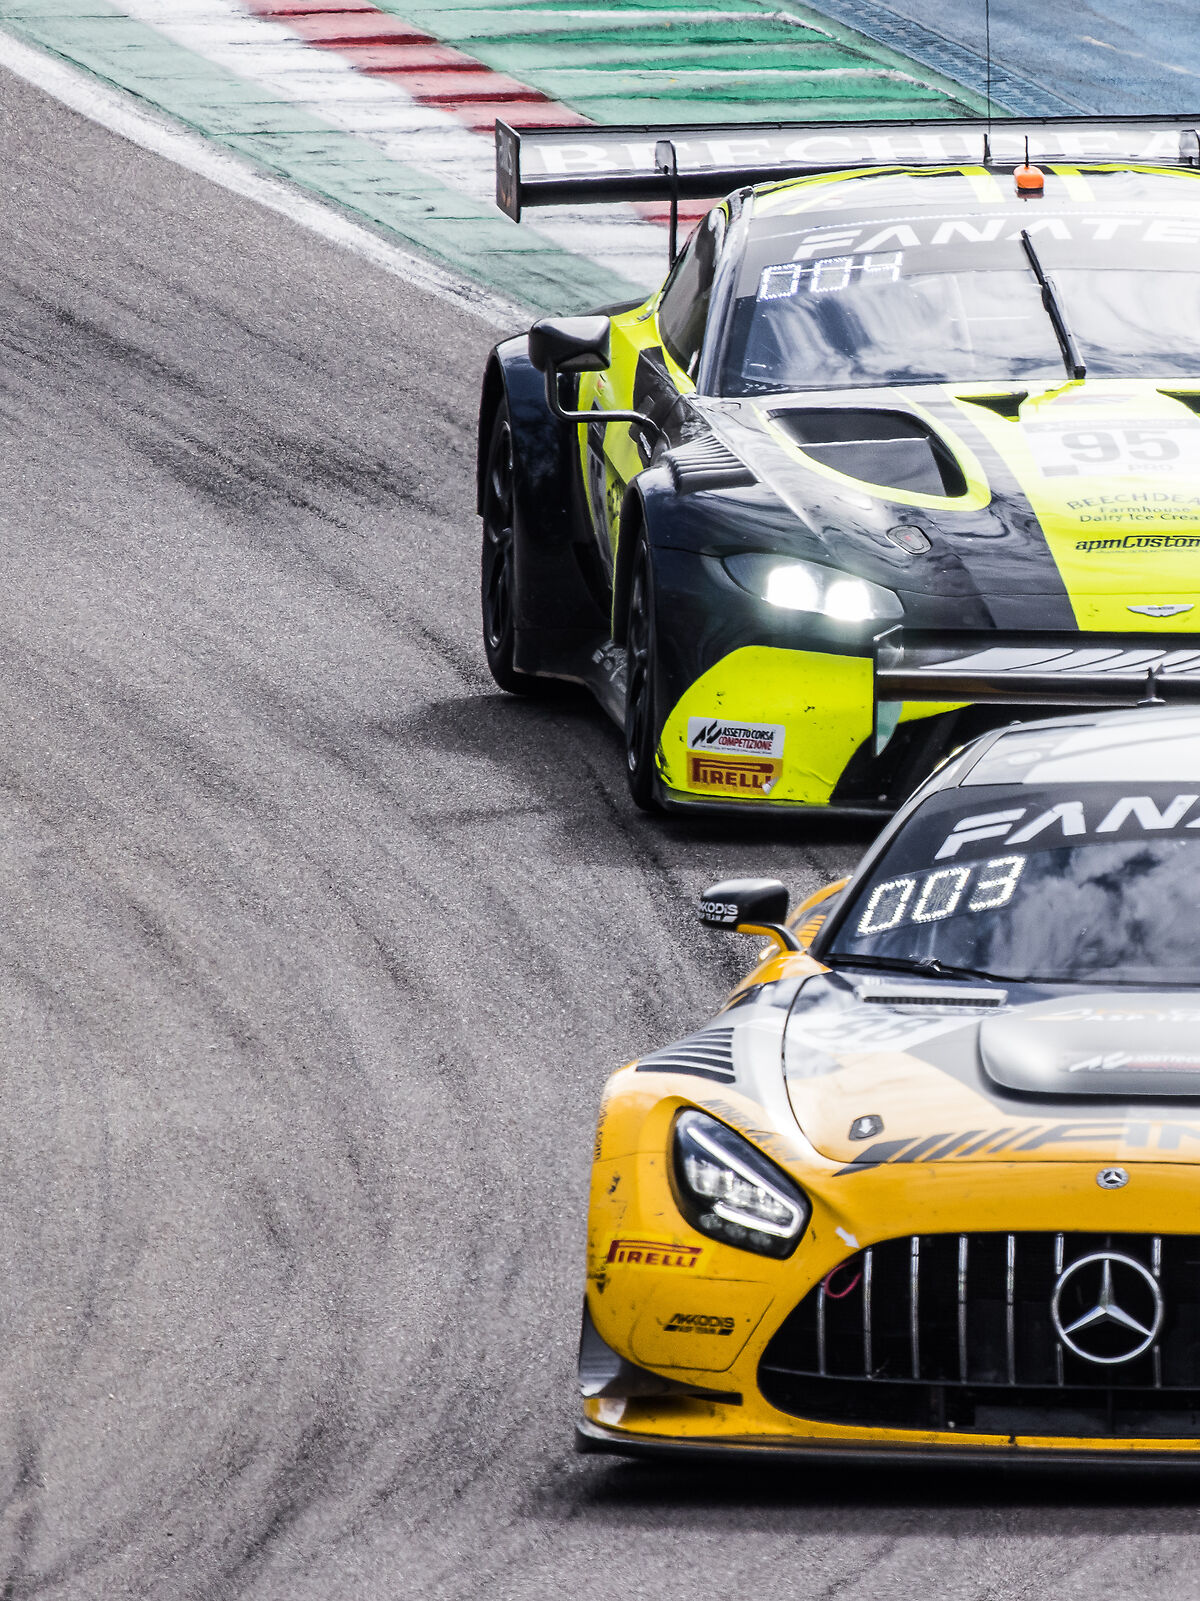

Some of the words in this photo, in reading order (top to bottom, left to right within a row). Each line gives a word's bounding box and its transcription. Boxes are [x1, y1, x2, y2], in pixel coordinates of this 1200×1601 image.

[1061, 430, 1181, 463] 95
[1080, 514, 1123, 523] Dairy
[1130, 513, 1155, 521] Ice
[1100, 504, 1191, 514] Farmhouse
[718, 735, 773, 751] COMPETIZIONE
[721, 727, 751, 738] ASSETTO
[751, 730, 775, 741] CORSA
[692, 757, 774, 788] PIRELLI
[857, 856, 1026, 937] 003
[606, 1240, 703, 1268] PIRELLI
